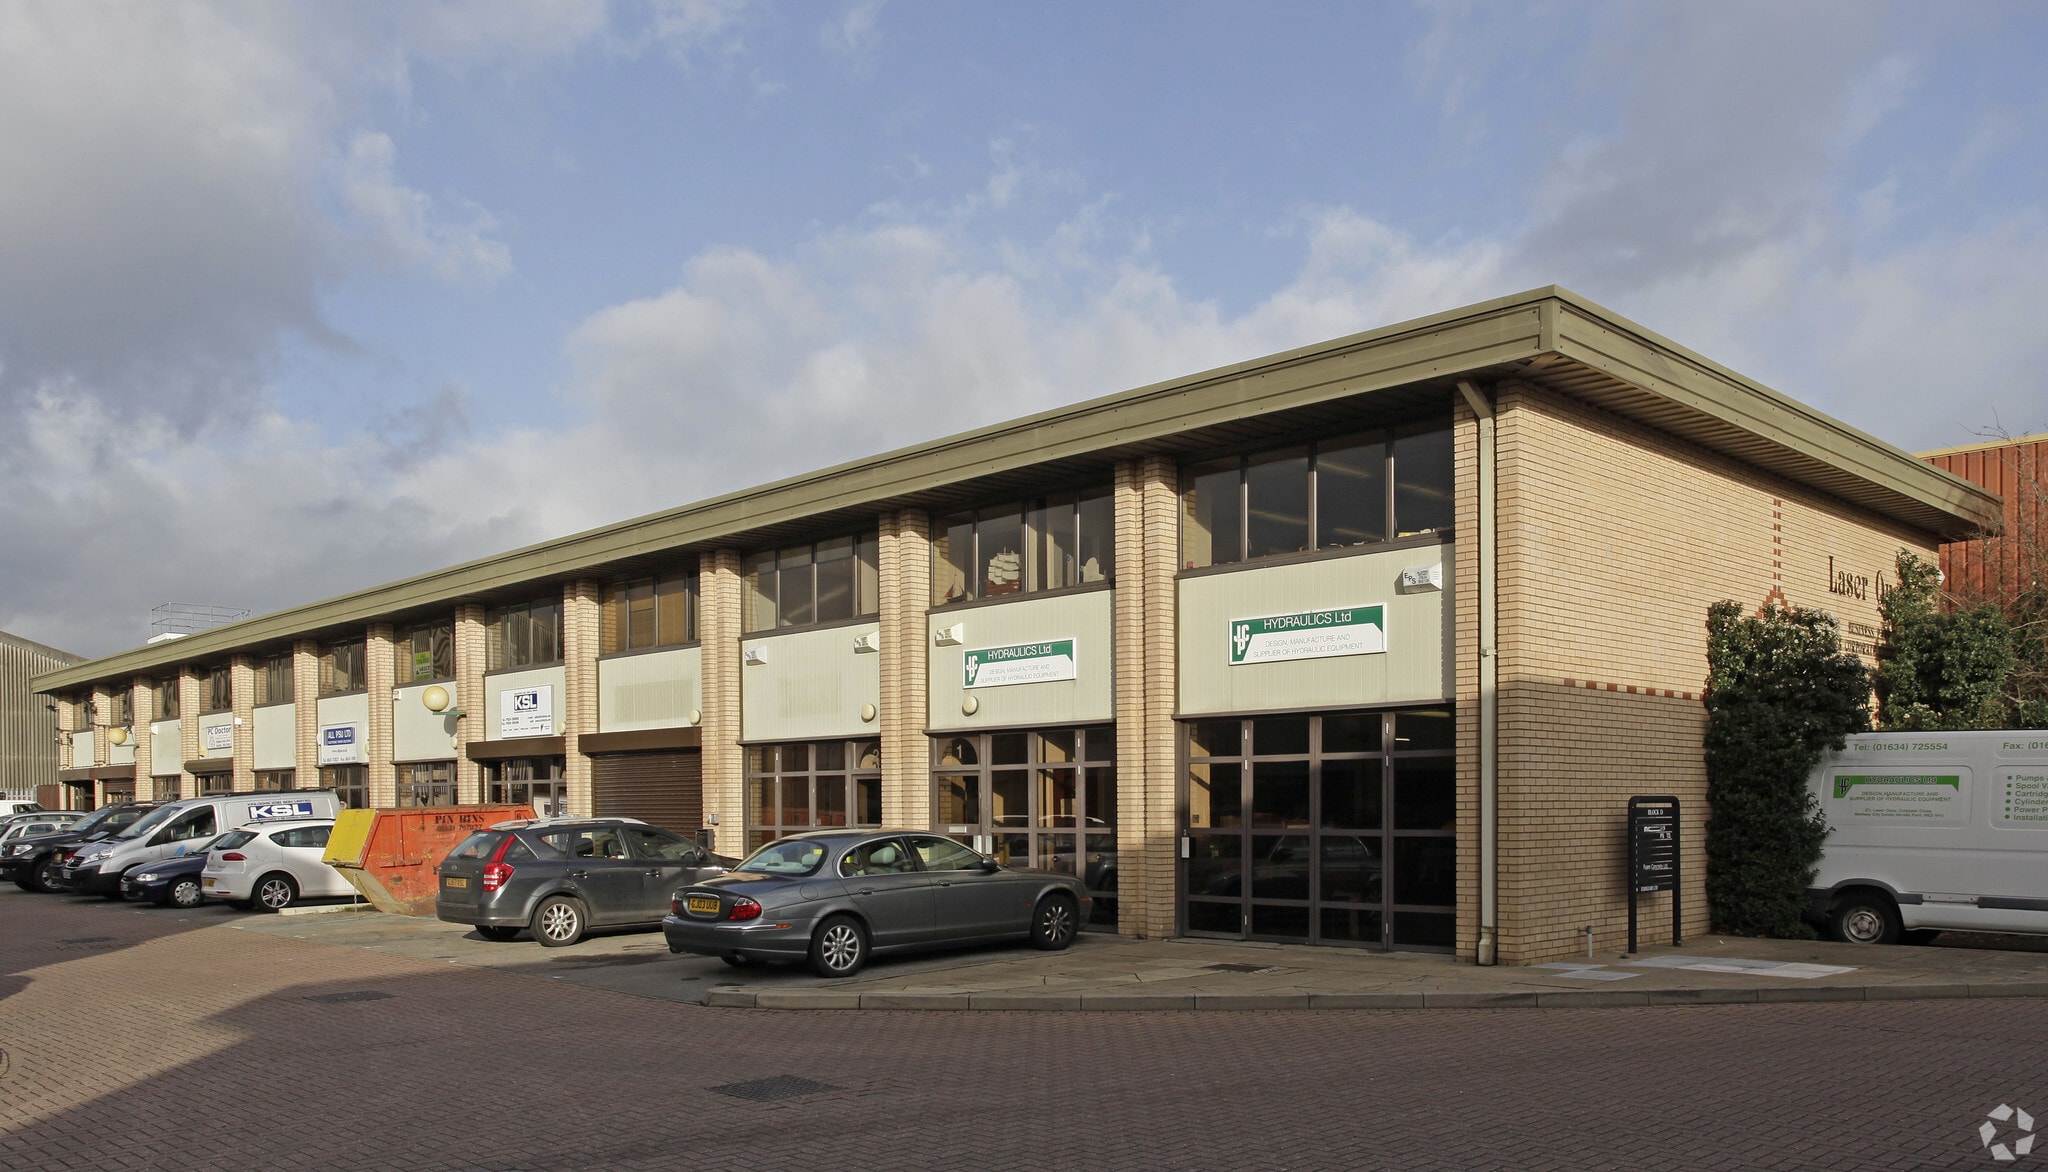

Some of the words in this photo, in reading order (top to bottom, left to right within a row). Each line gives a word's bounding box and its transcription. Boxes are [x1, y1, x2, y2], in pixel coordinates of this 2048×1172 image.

[1404, 572, 1417, 585] EPS
[1828, 555, 1868, 601] Laser
[1263, 612, 1332, 630] HYDRAULICS
[1335, 610, 1352, 623] Ltd
[1290, 634, 1336, 646] MANUFACTURE
[1336, 633, 1351, 641] AND
[987, 645, 1037, 660] HYDRAULICS
[1038, 644, 1051, 655] Ltd
[1253, 649, 1281, 658] SUPPLIER
[1281, 648, 1291, 656] OF
[1291, 645, 1325, 655] HYDRAULIC
[1326, 642, 1363, 653] EQUIPMENT
[1006, 664, 1039, 674] MANUFACTURE
[1033, 670, 1059, 679] EQUIPMENT
[514, 694, 538, 710] KSL
[214, 727, 231, 735] Doctor
[328, 731, 336, 739] ALL
[335, 730, 344, 738] PSU
[344, 729, 352, 738] LTD
[956, 744, 962, 759] 1
[1853, 743, 1870, 751] Tel:
[1873, 743, 1909, 752] (01634)
[1912, 743, 1948, 751] 725554
[2002, 742, 2024, 750] Fax:
[1864, 776, 1921, 784] HYDRAULICS
[1922, 776, 1938, 784] Ltd
[2015, 774, 2044, 782] Pumps
[249, 803, 311, 819] KSL
[434, 815, 454, 825] PIN
[459, 814, 485, 824] BINS
